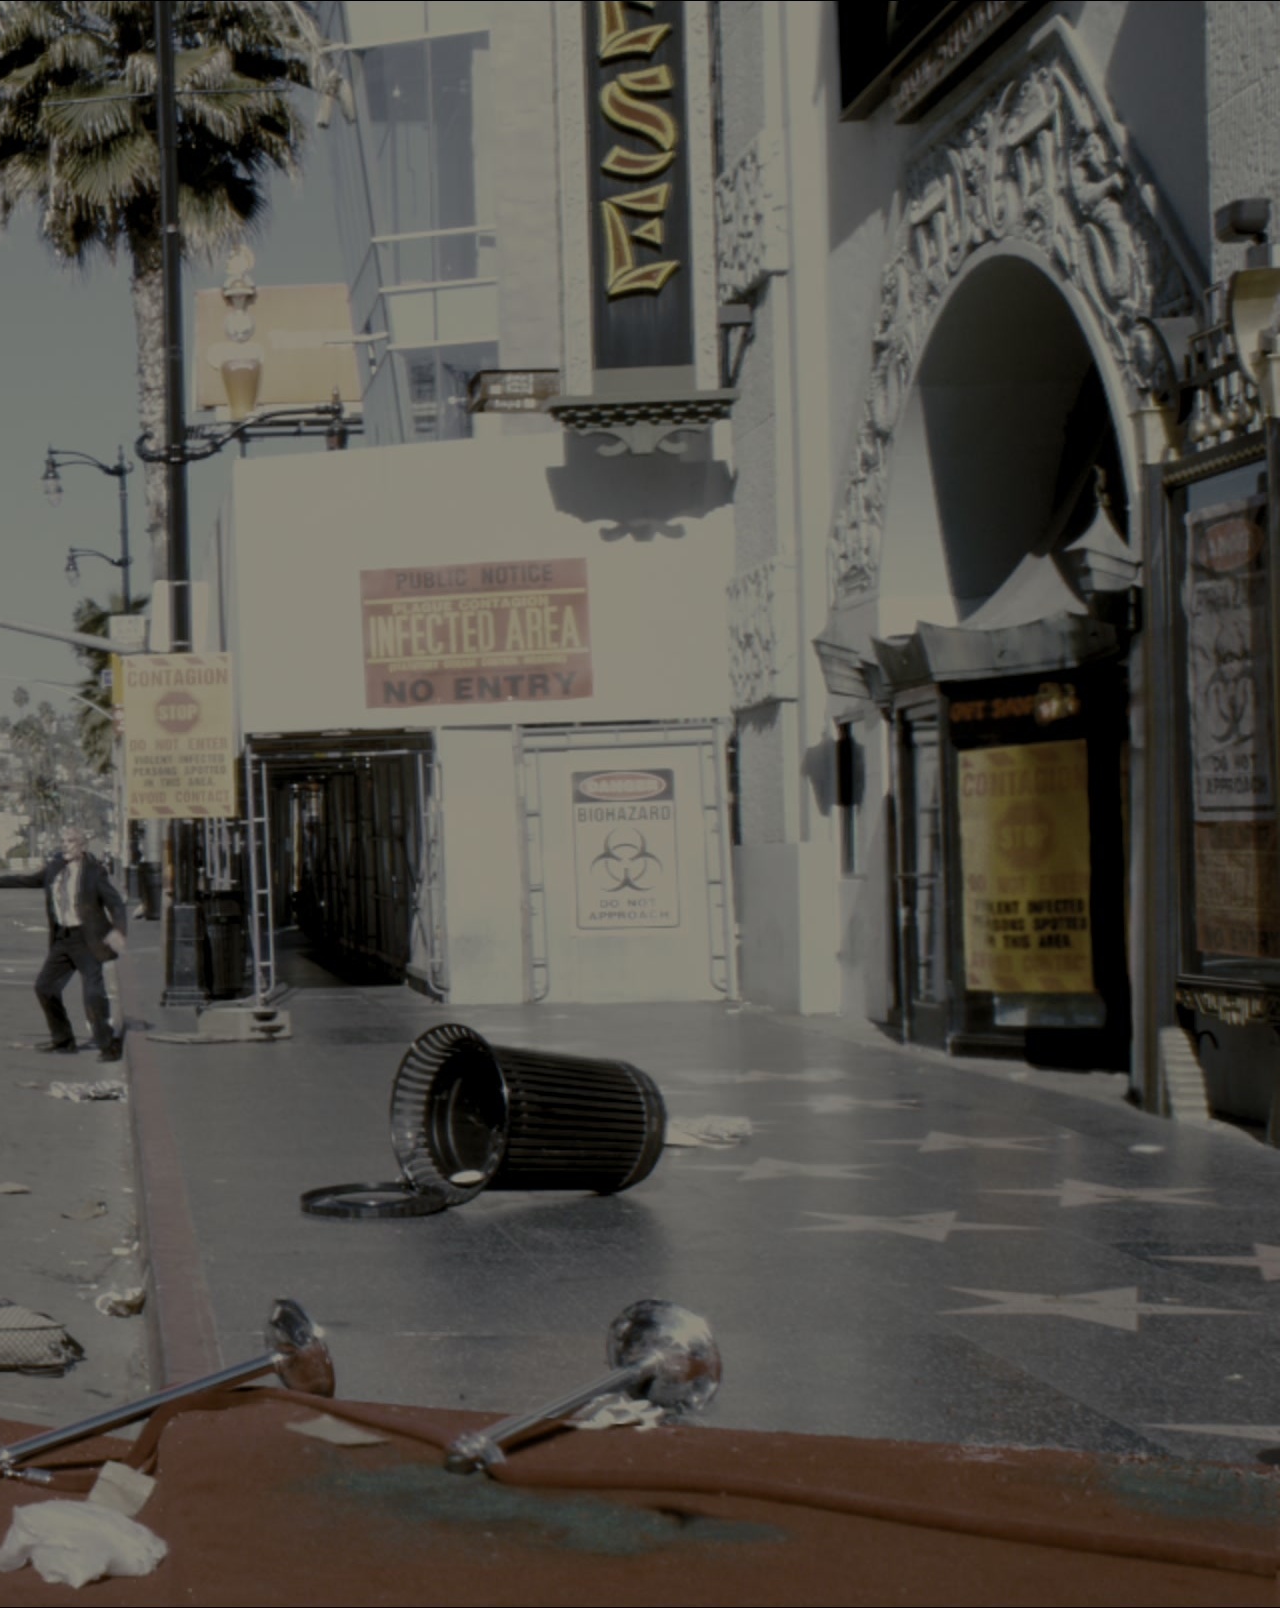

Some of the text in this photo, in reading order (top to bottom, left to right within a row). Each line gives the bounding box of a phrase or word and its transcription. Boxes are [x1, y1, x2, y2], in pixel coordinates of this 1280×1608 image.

[395, 563, 554, 591] PUBLIC NOTICE
[392, 596, 550, 614] PLAGUE CONTAGION
[369, 605, 582, 659] INFECTED AREA
[127, 667, 229, 687] CONTAGION
[383, 671, 577, 703] NO ENTRY
[158, 704, 199, 721] STOP
[130, 737, 227, 751] DO NOT ENTER
[175, 790, 230, 804] CONTACT
[577, 806, 672, 823] BIOHAZARD
[599, 898, 657, 909] DO NOT
[589, 911, 670, 921] APPROACH
